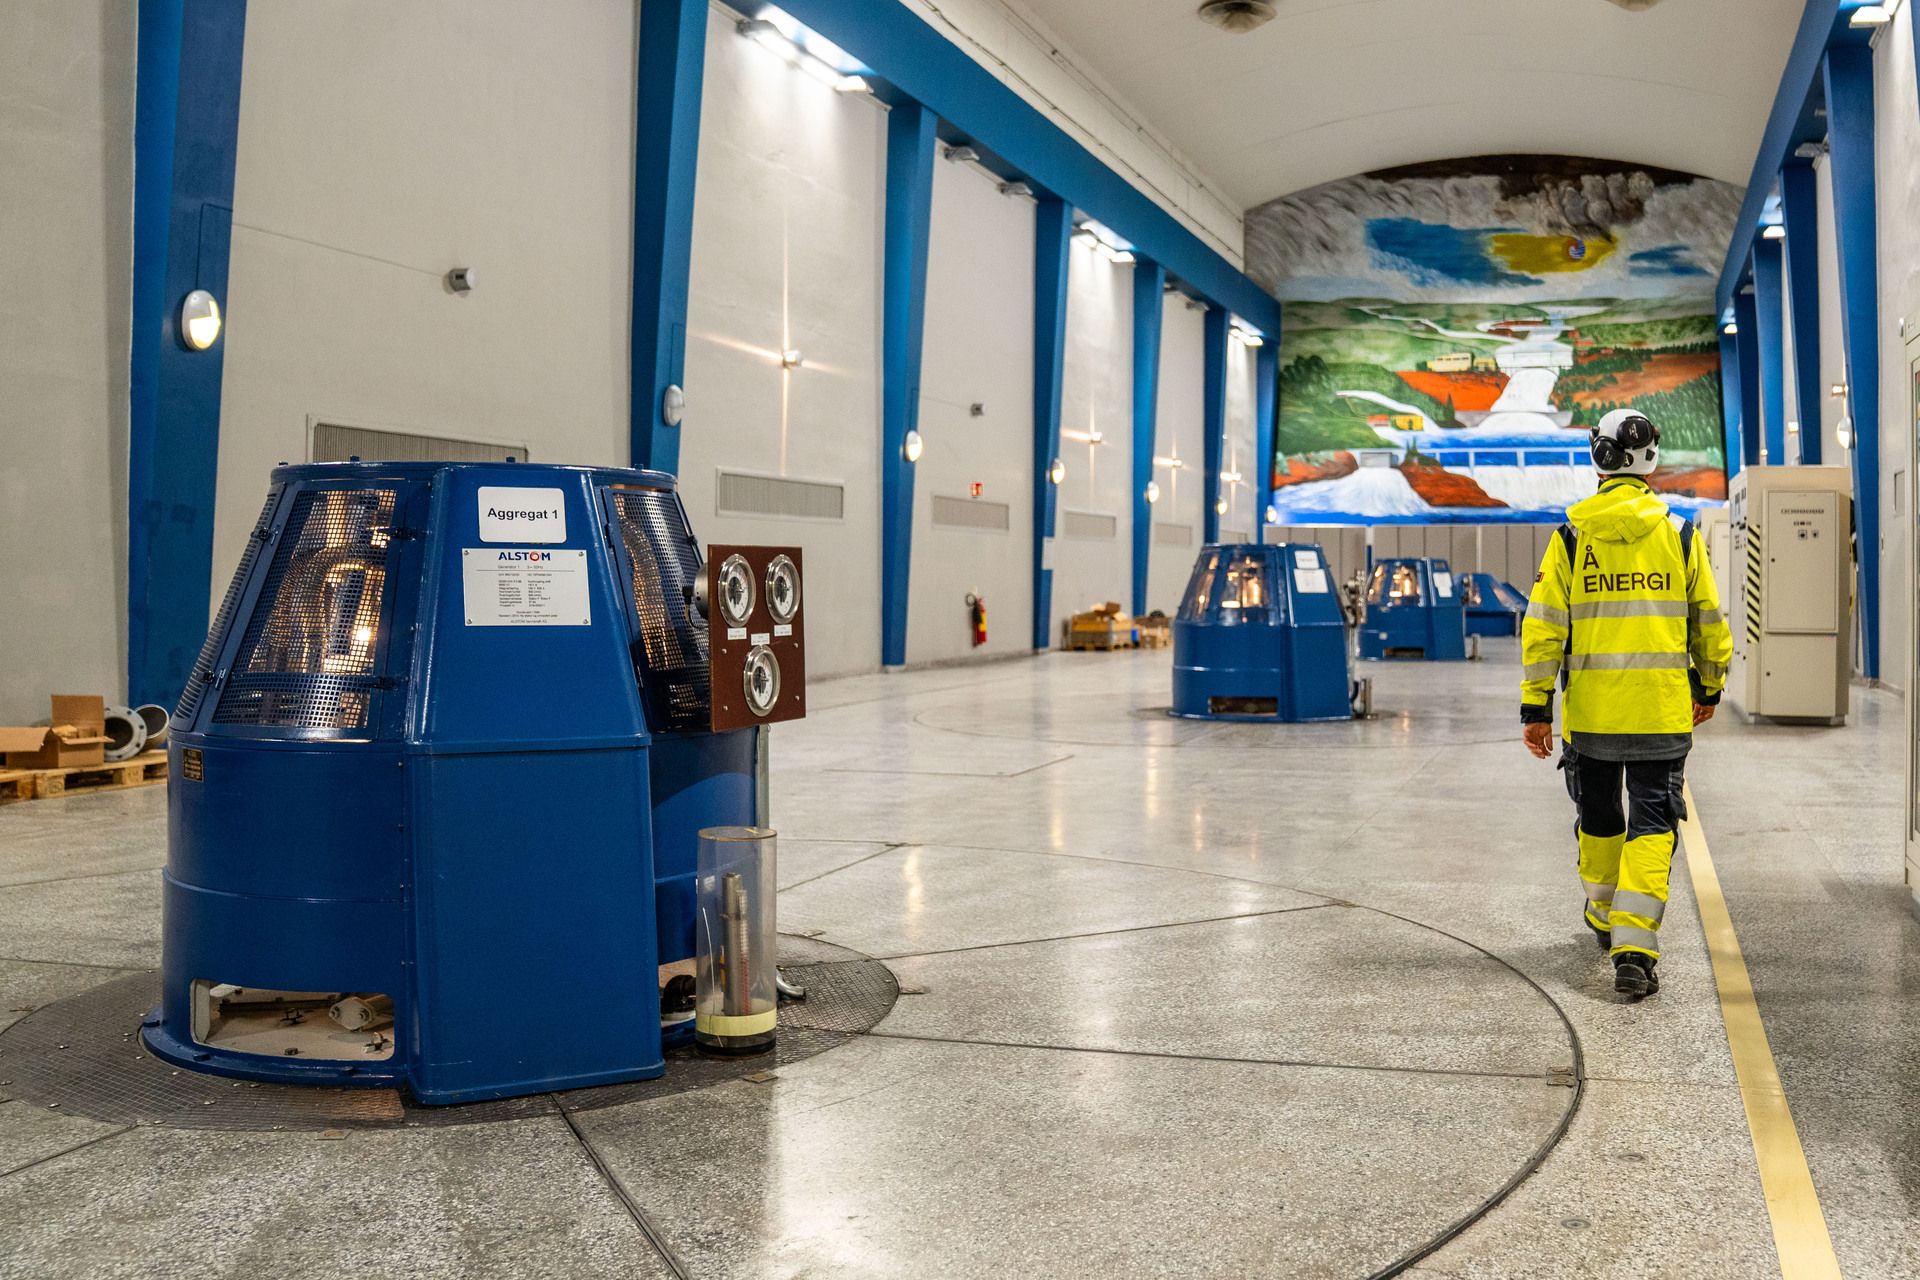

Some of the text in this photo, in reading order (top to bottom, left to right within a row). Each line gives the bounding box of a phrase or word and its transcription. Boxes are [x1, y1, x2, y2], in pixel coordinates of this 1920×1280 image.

[487, 507, 558, 521] Aggregat 1
[498, 551, 551, 562] ALSTOM
[1582, 544, 1600, 571] Å
[1583, 572, 1671, 594] ENERGI
